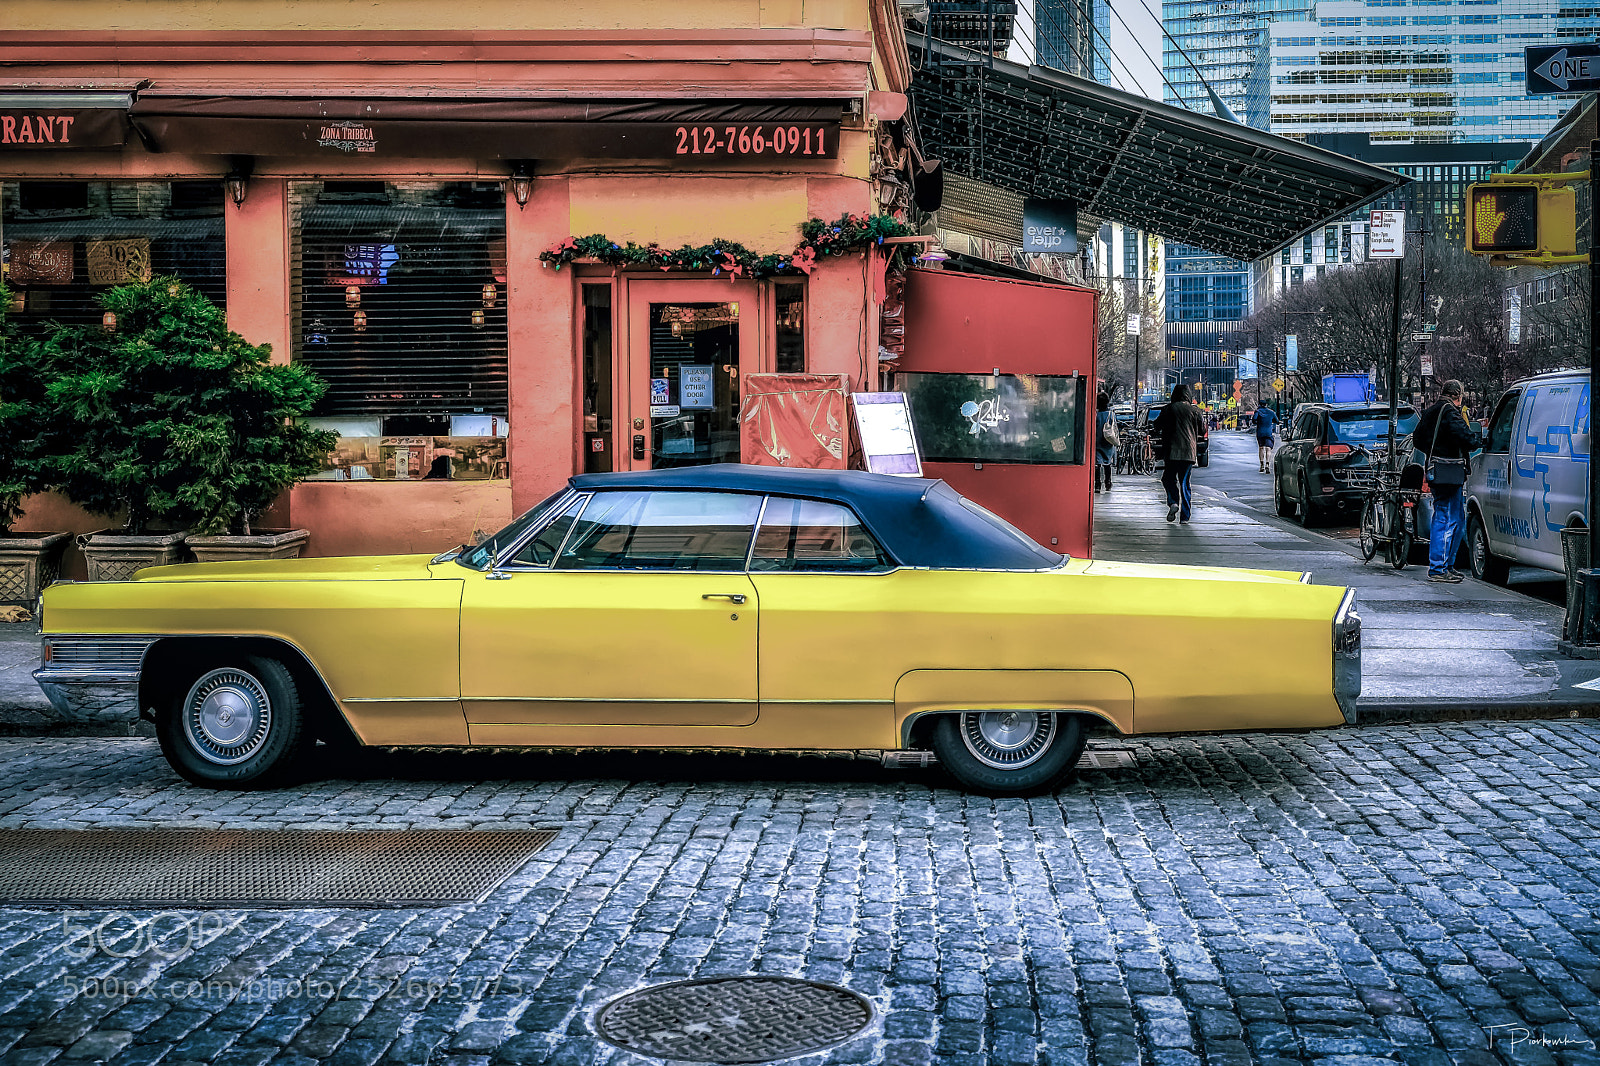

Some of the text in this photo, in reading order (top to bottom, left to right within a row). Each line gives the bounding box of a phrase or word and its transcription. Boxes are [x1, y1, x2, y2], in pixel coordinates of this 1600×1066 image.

[1549, 59, 1591, 79] ONE
[1, 115, 75, 144] RANT
[320, 126, 374, 140] ZONA TRIBECA
[675, 125, 826, 155] 212-766-0911
[1027, 226, 1057, 236] ever
[652, 395, 667, 403] PULL
[1492, 514, 1531, 540] PLUMBING
